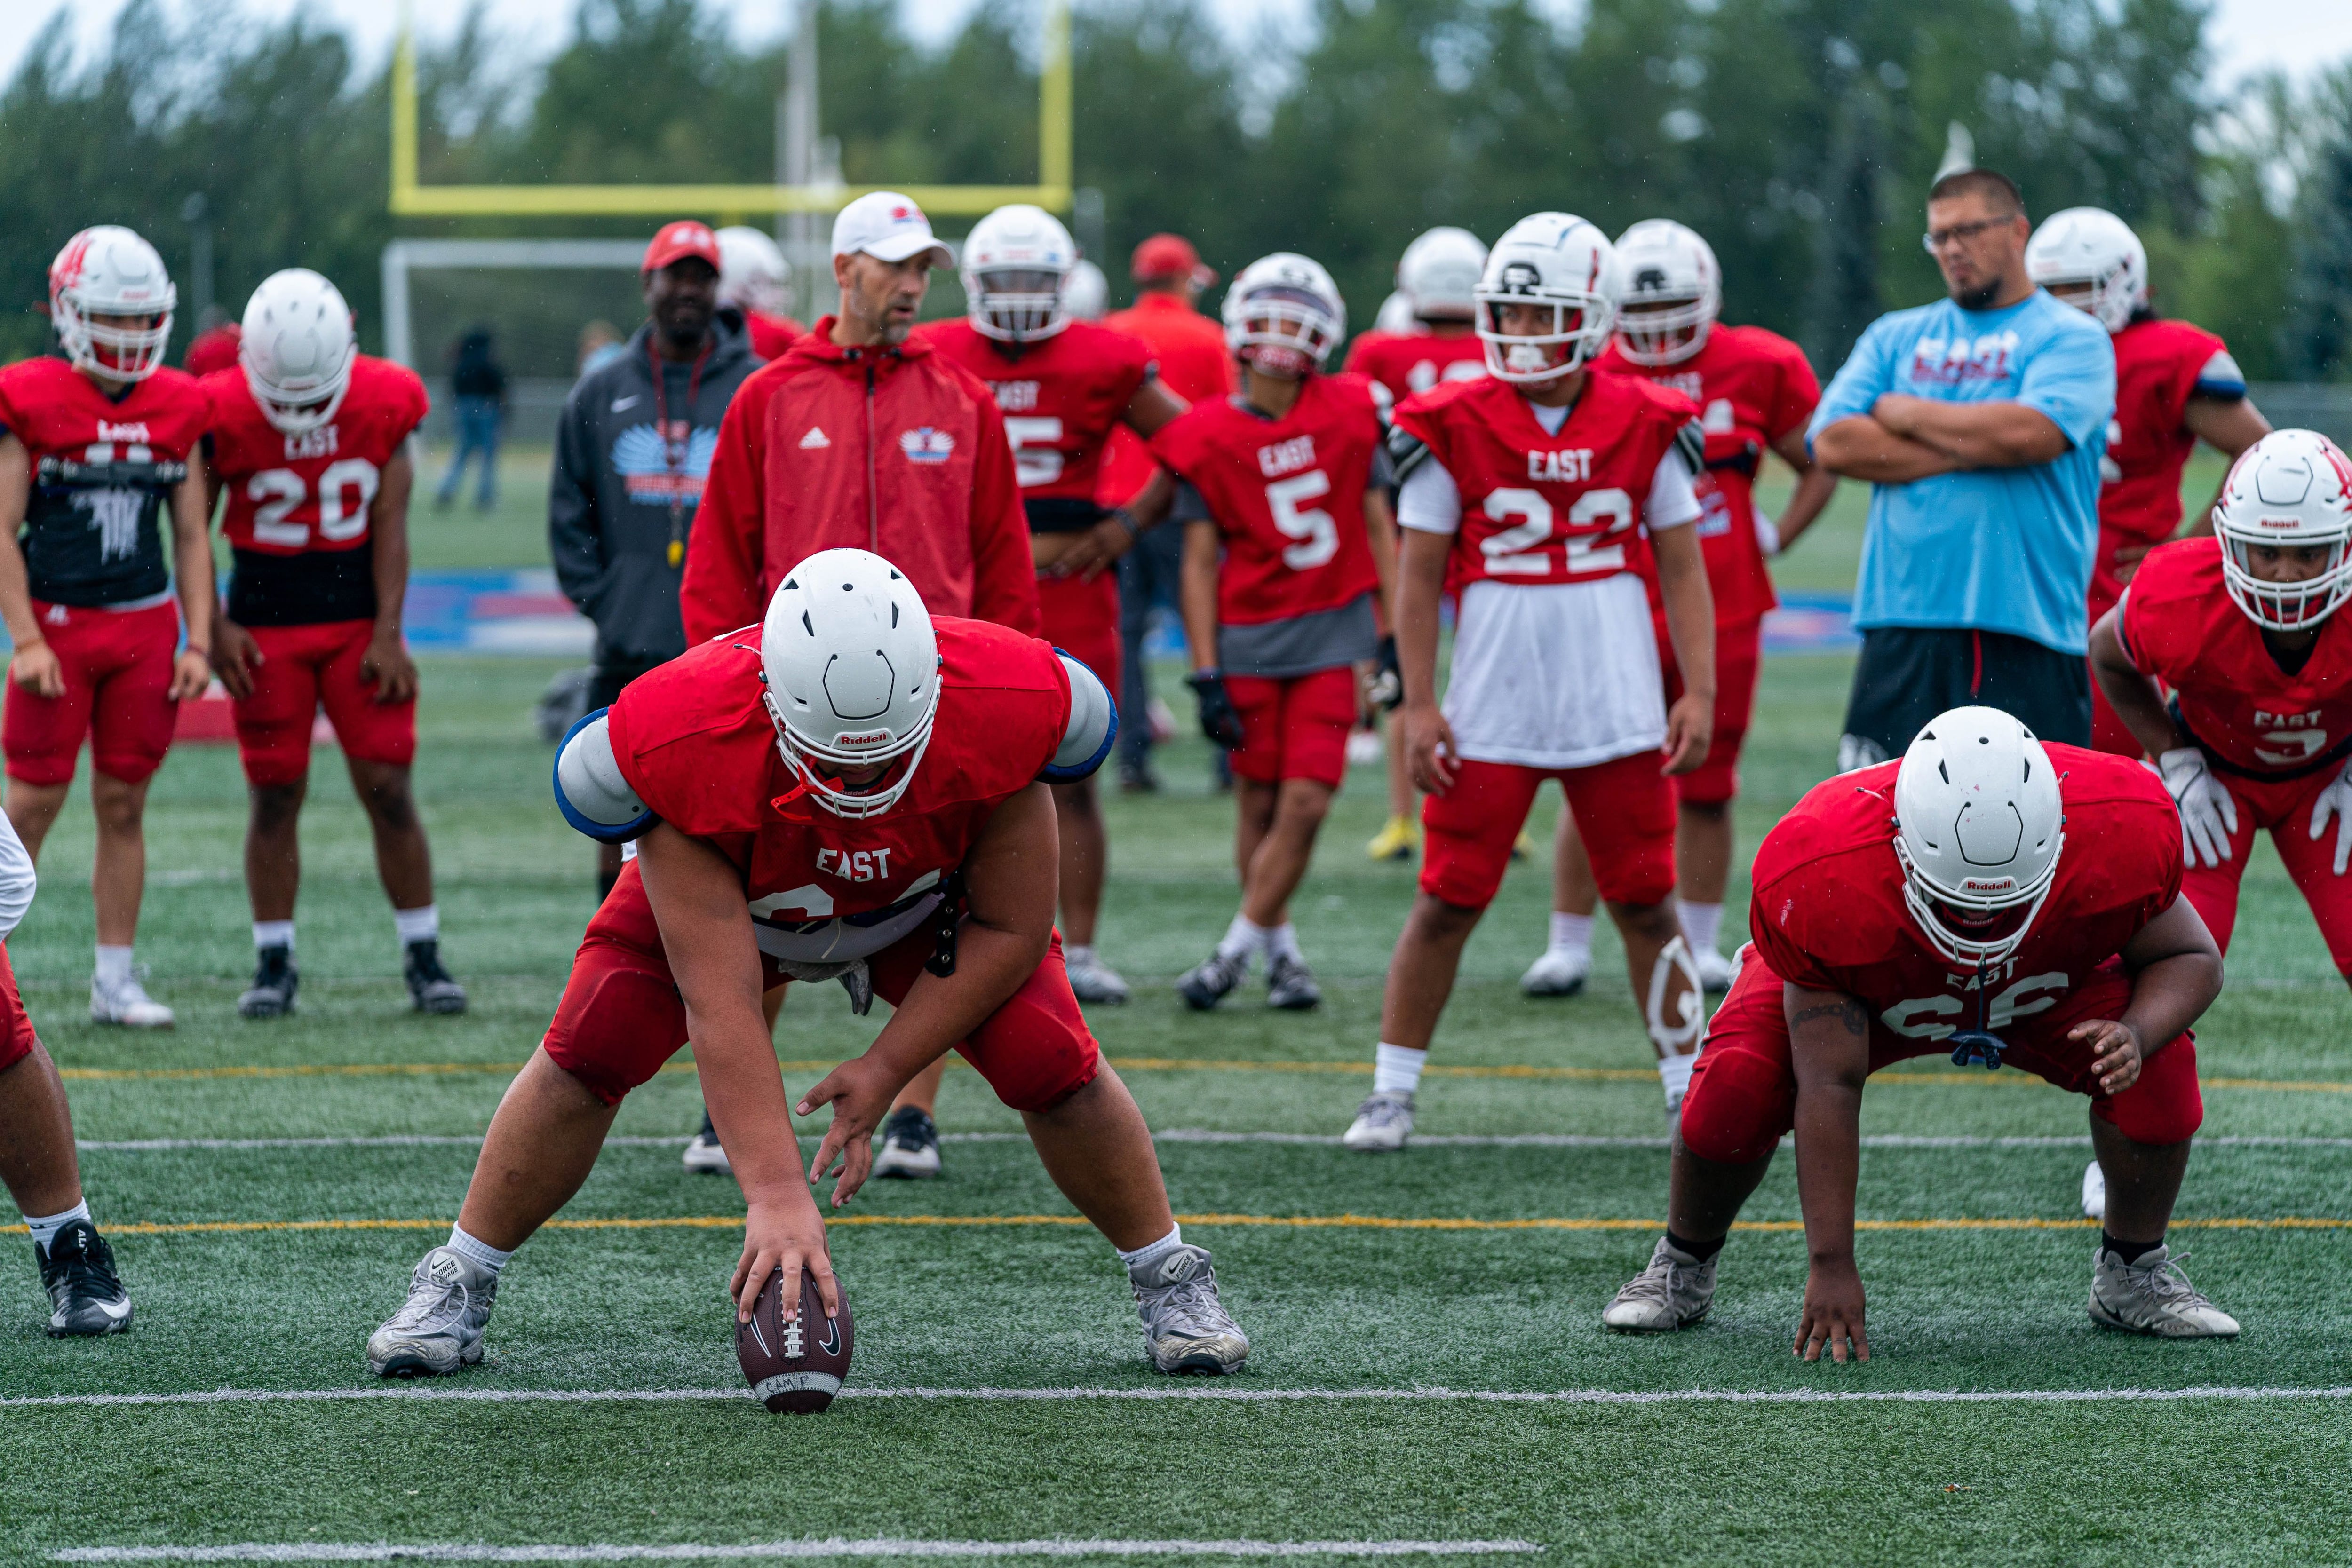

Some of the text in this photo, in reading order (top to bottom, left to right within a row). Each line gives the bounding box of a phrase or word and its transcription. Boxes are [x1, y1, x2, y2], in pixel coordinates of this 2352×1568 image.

[1256, 434, 1317, 478] EAST
[1527, 448, 1594, 483] EAST
[246, 456, 380, 548] 20
[1264, 468, 1340, 572] 5
[1479, 487, 1634, 576] 22
[2261, 519, 2299, 528] Riddell
[841, 732, 887, 744] Riddell
[816, 848, 891, 882] EAST
[1967, 876, 2011, 890] Riddell
[438, 1267, 458, 1283] SVAGE
[1176, 1254, 1191, 1279] FORCE
